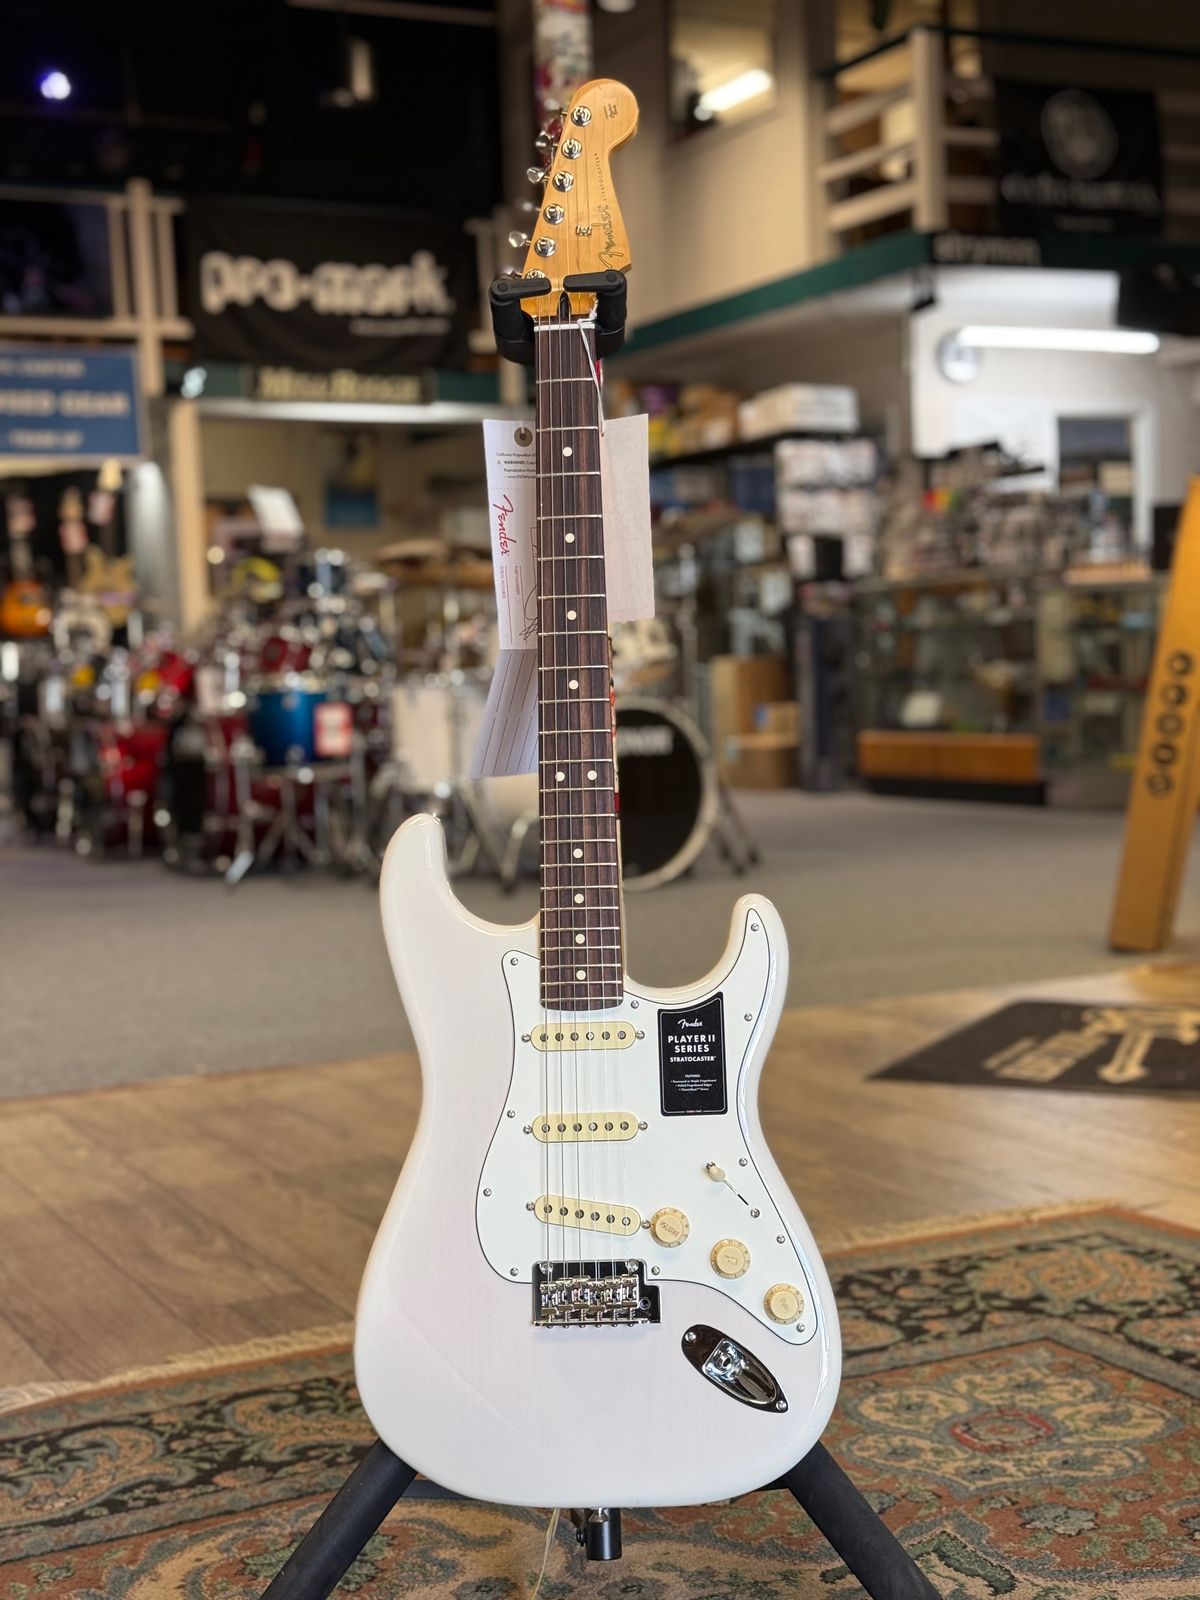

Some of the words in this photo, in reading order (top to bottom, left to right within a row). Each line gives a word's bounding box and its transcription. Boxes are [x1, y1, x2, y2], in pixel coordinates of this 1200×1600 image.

[591, 204, 625, 269] Fender
[492, 494, 517, 556] Fender
[677, 1018, 703, 1029] Fender
[668, 1034, 706, 1043] PLAYER
[708, 1034, 716, 1042] II
[674, 1044, 710, 1053] SERIES
